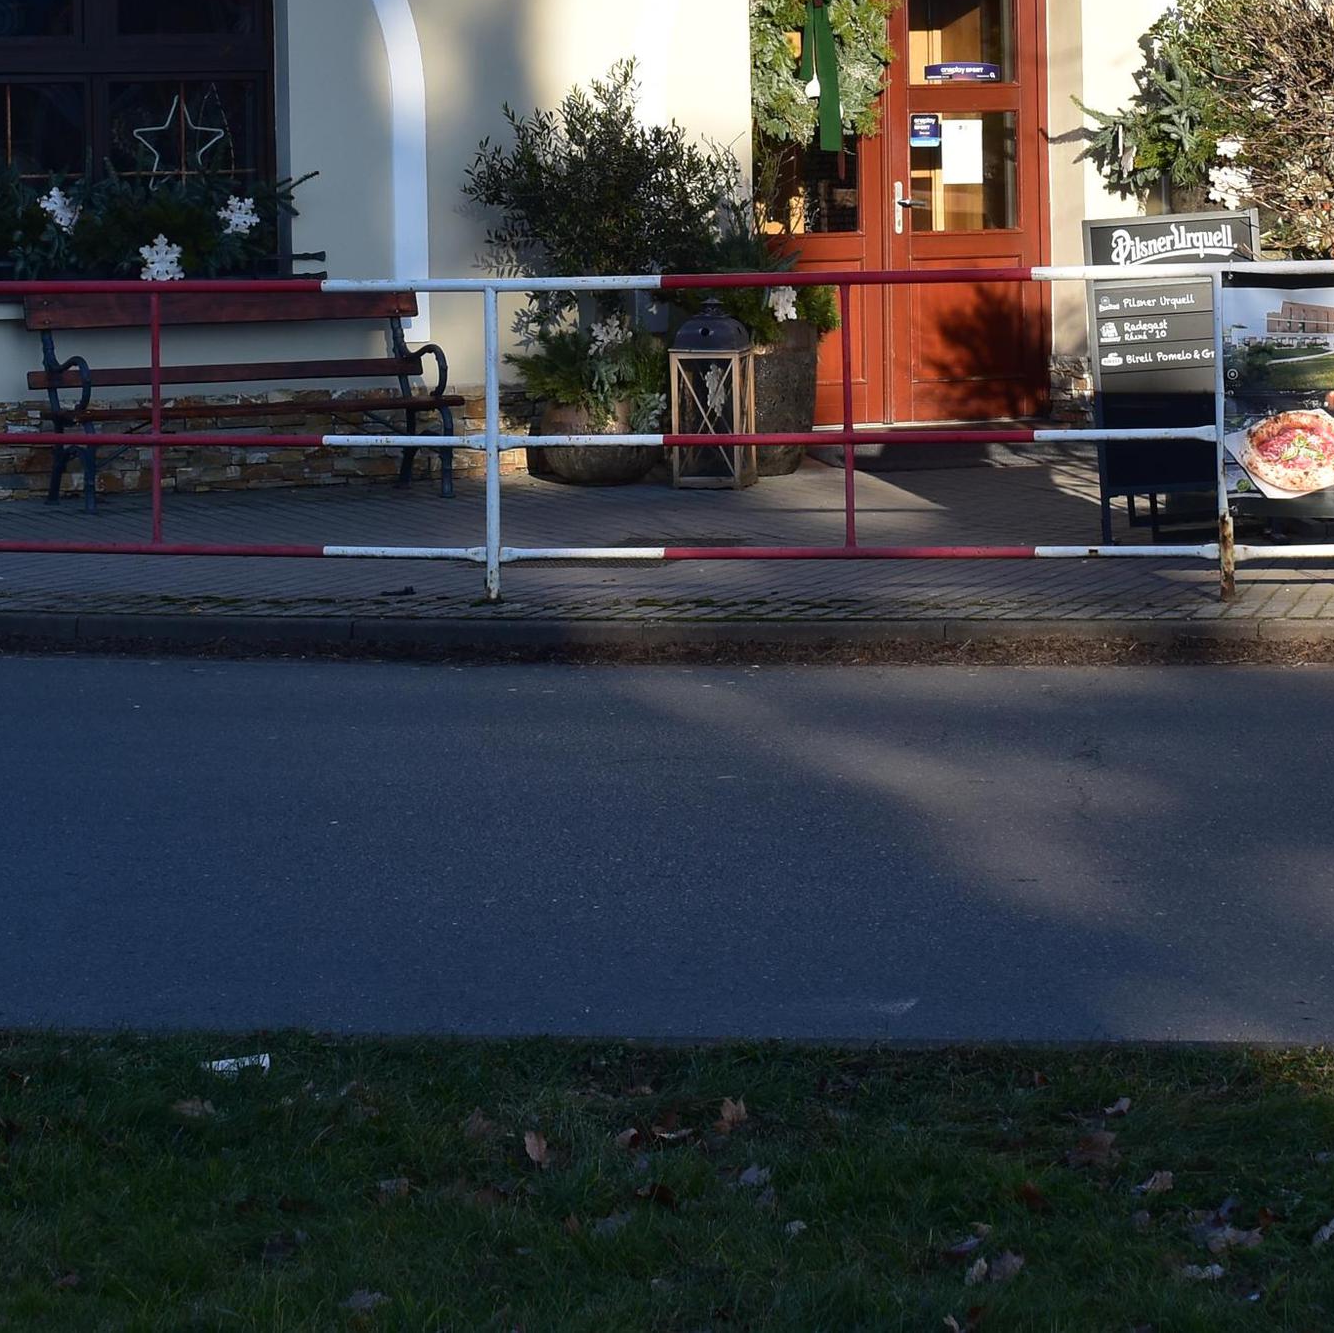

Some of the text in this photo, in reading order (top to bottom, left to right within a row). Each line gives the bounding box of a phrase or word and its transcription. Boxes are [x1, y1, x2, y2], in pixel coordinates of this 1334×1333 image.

[1111, 223, 1232, 266] Pilsner Urquell
[1123, 297, 1157, 308] Pilsner
[1160, 294, 1195, 309] Urquell
[1123, 319, 1168, 333] Radegast
[1155, 330, 1167, 339] 10
[1126, 350, 1153, 364] Birell
[1157, 348, 1191, 361] Pomelo
[1193, 349, 1201, 359] &
